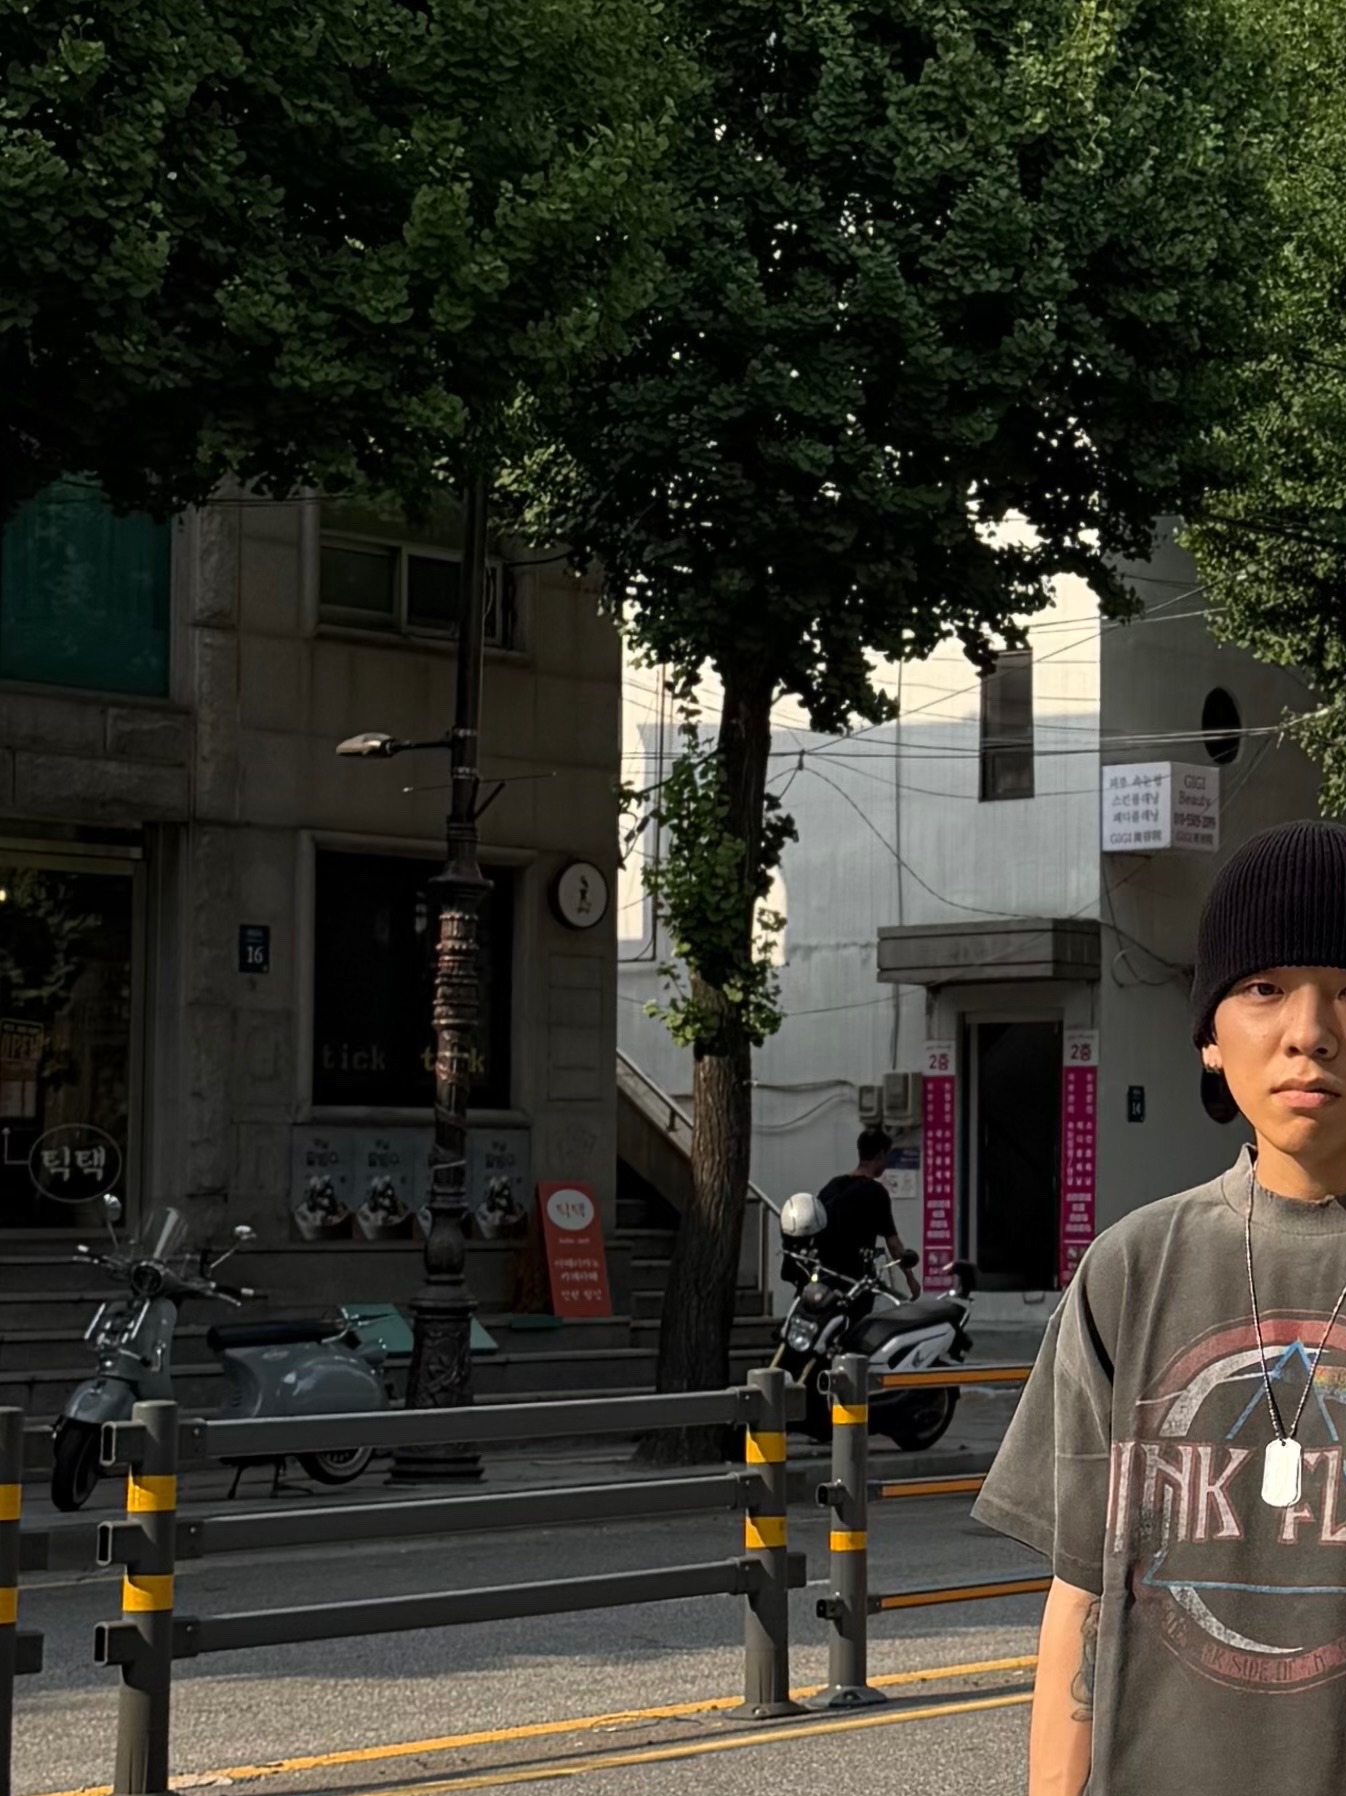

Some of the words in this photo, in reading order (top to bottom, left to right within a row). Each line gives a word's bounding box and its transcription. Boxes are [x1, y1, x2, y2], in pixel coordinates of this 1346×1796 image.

[245, 944, 264, 964] 16
[319, 1041, 387, 1072] tick
[420, 1045, 485, 1073] tk
[41, 1145, 107, 1183] 틱택
[1107, 1441, 1252, 1553] INK
